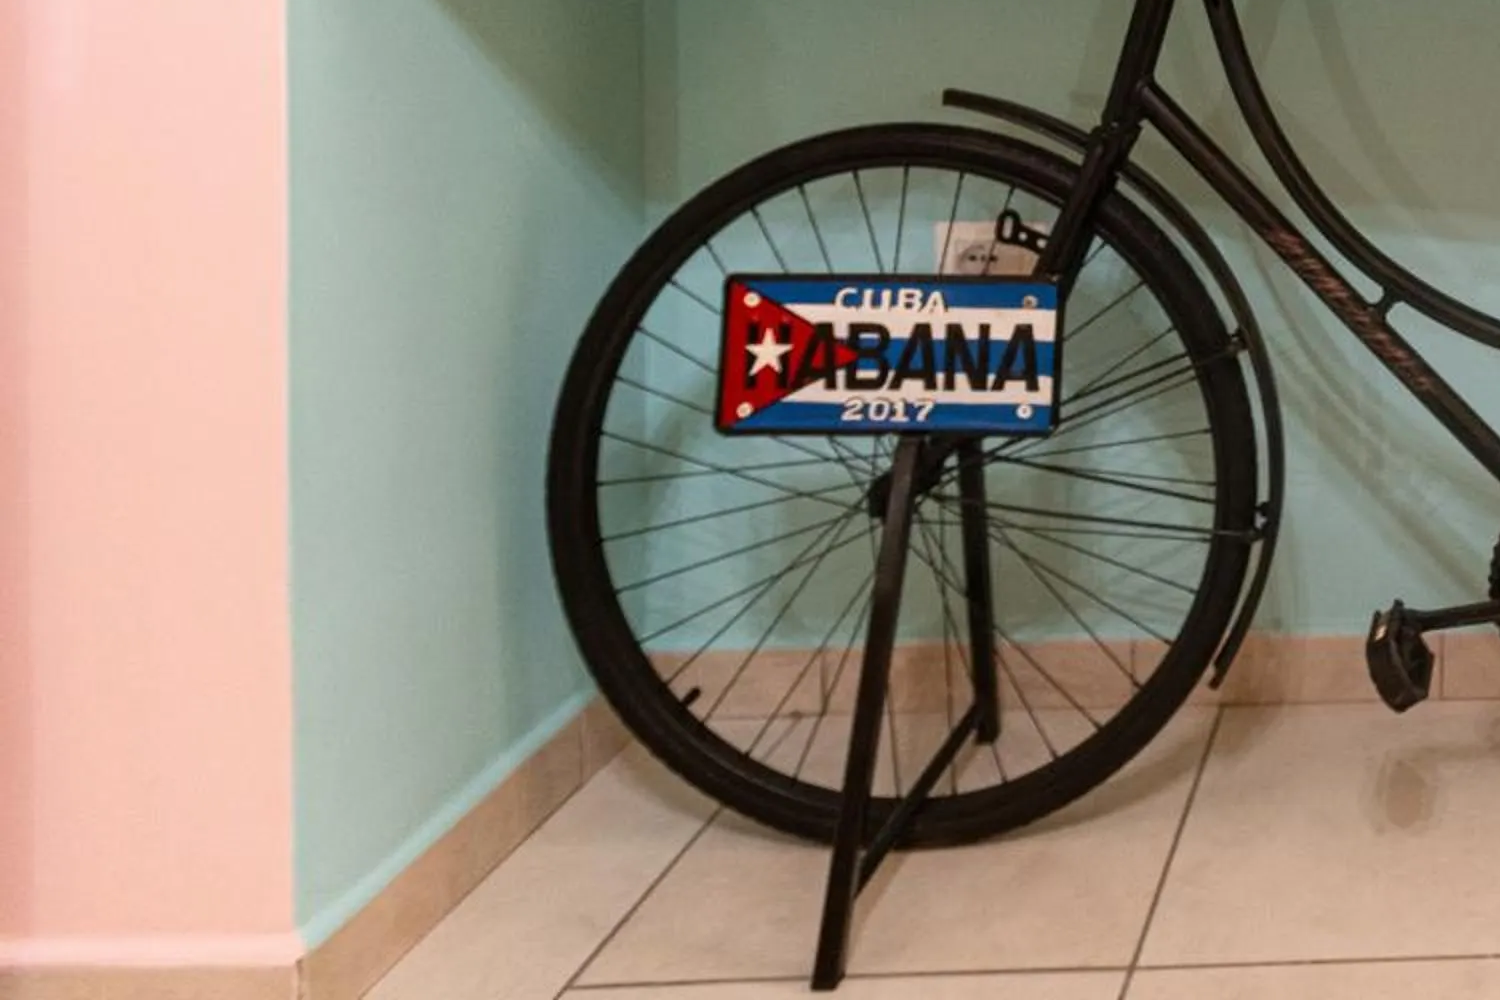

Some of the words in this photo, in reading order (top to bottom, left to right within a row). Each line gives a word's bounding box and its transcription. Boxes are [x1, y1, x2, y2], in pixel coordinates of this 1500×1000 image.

[835, 287, 949, 313] CUBA
[744, 322, 1040, 392] HABANA
[840, 397, 937, 422] 2017
